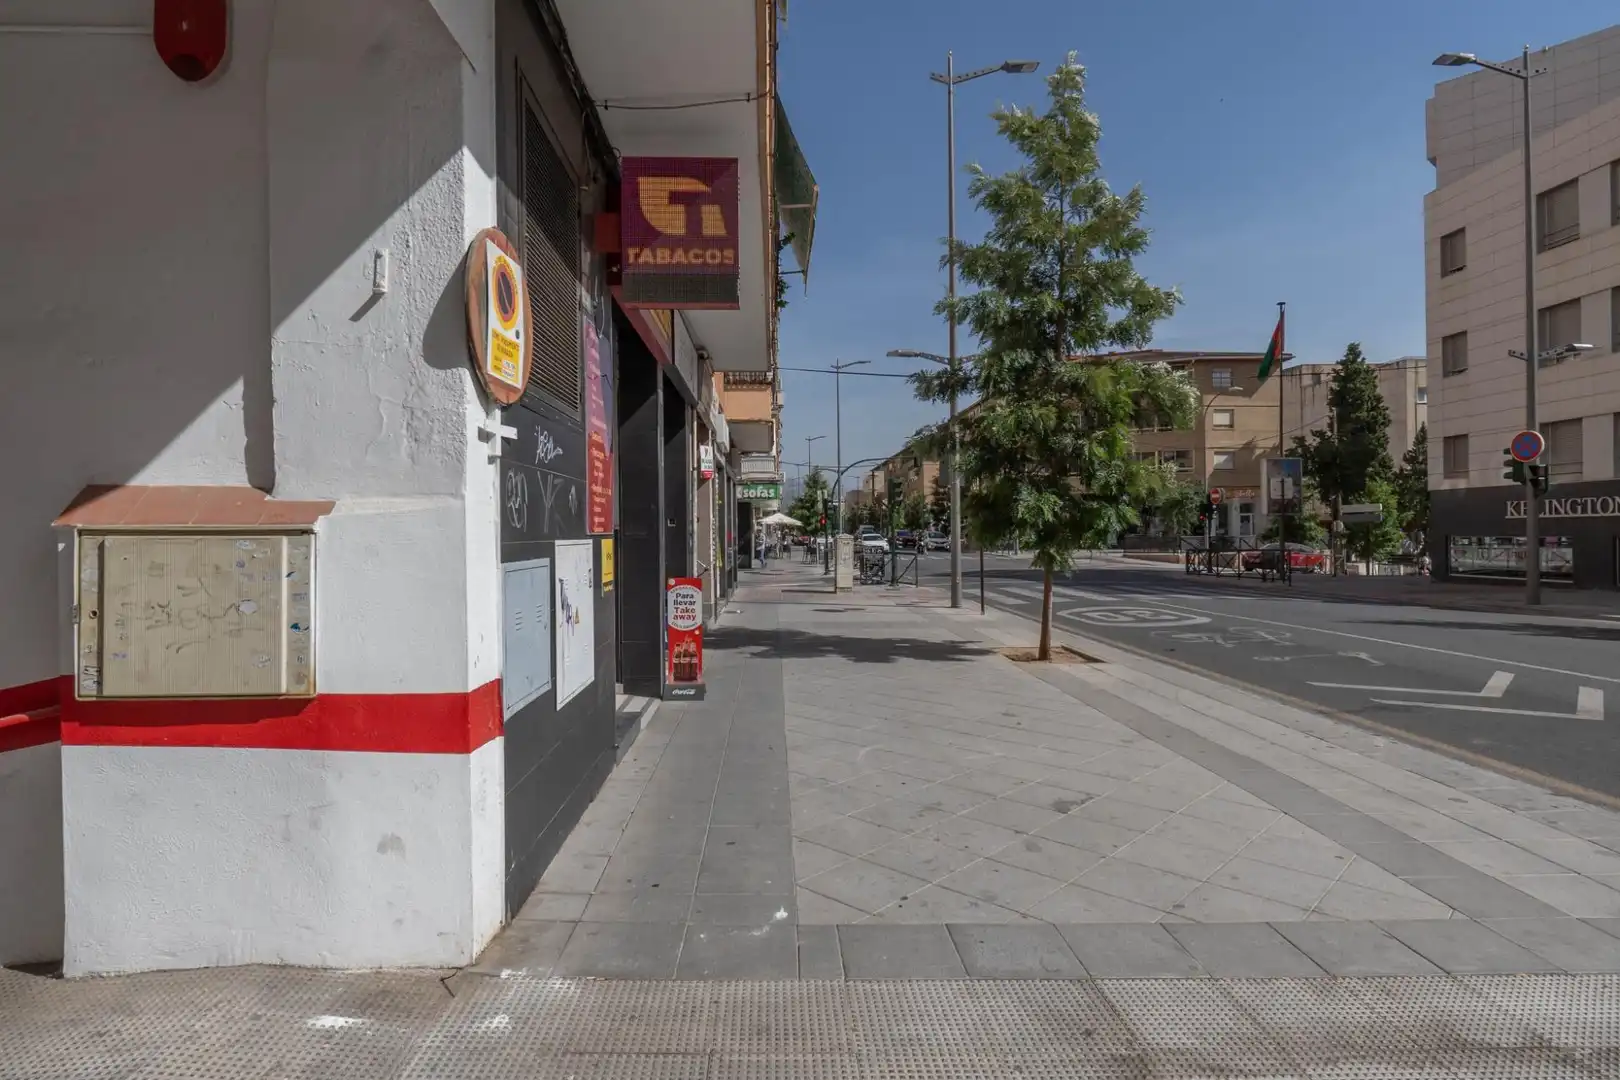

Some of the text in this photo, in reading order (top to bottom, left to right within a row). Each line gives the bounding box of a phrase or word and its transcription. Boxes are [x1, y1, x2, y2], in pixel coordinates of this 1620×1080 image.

[626, 247, 735, 265] TABACOS
[743, 485, 775, 498] sofas
[1505, 496, 1620, 518] KEINGTO
